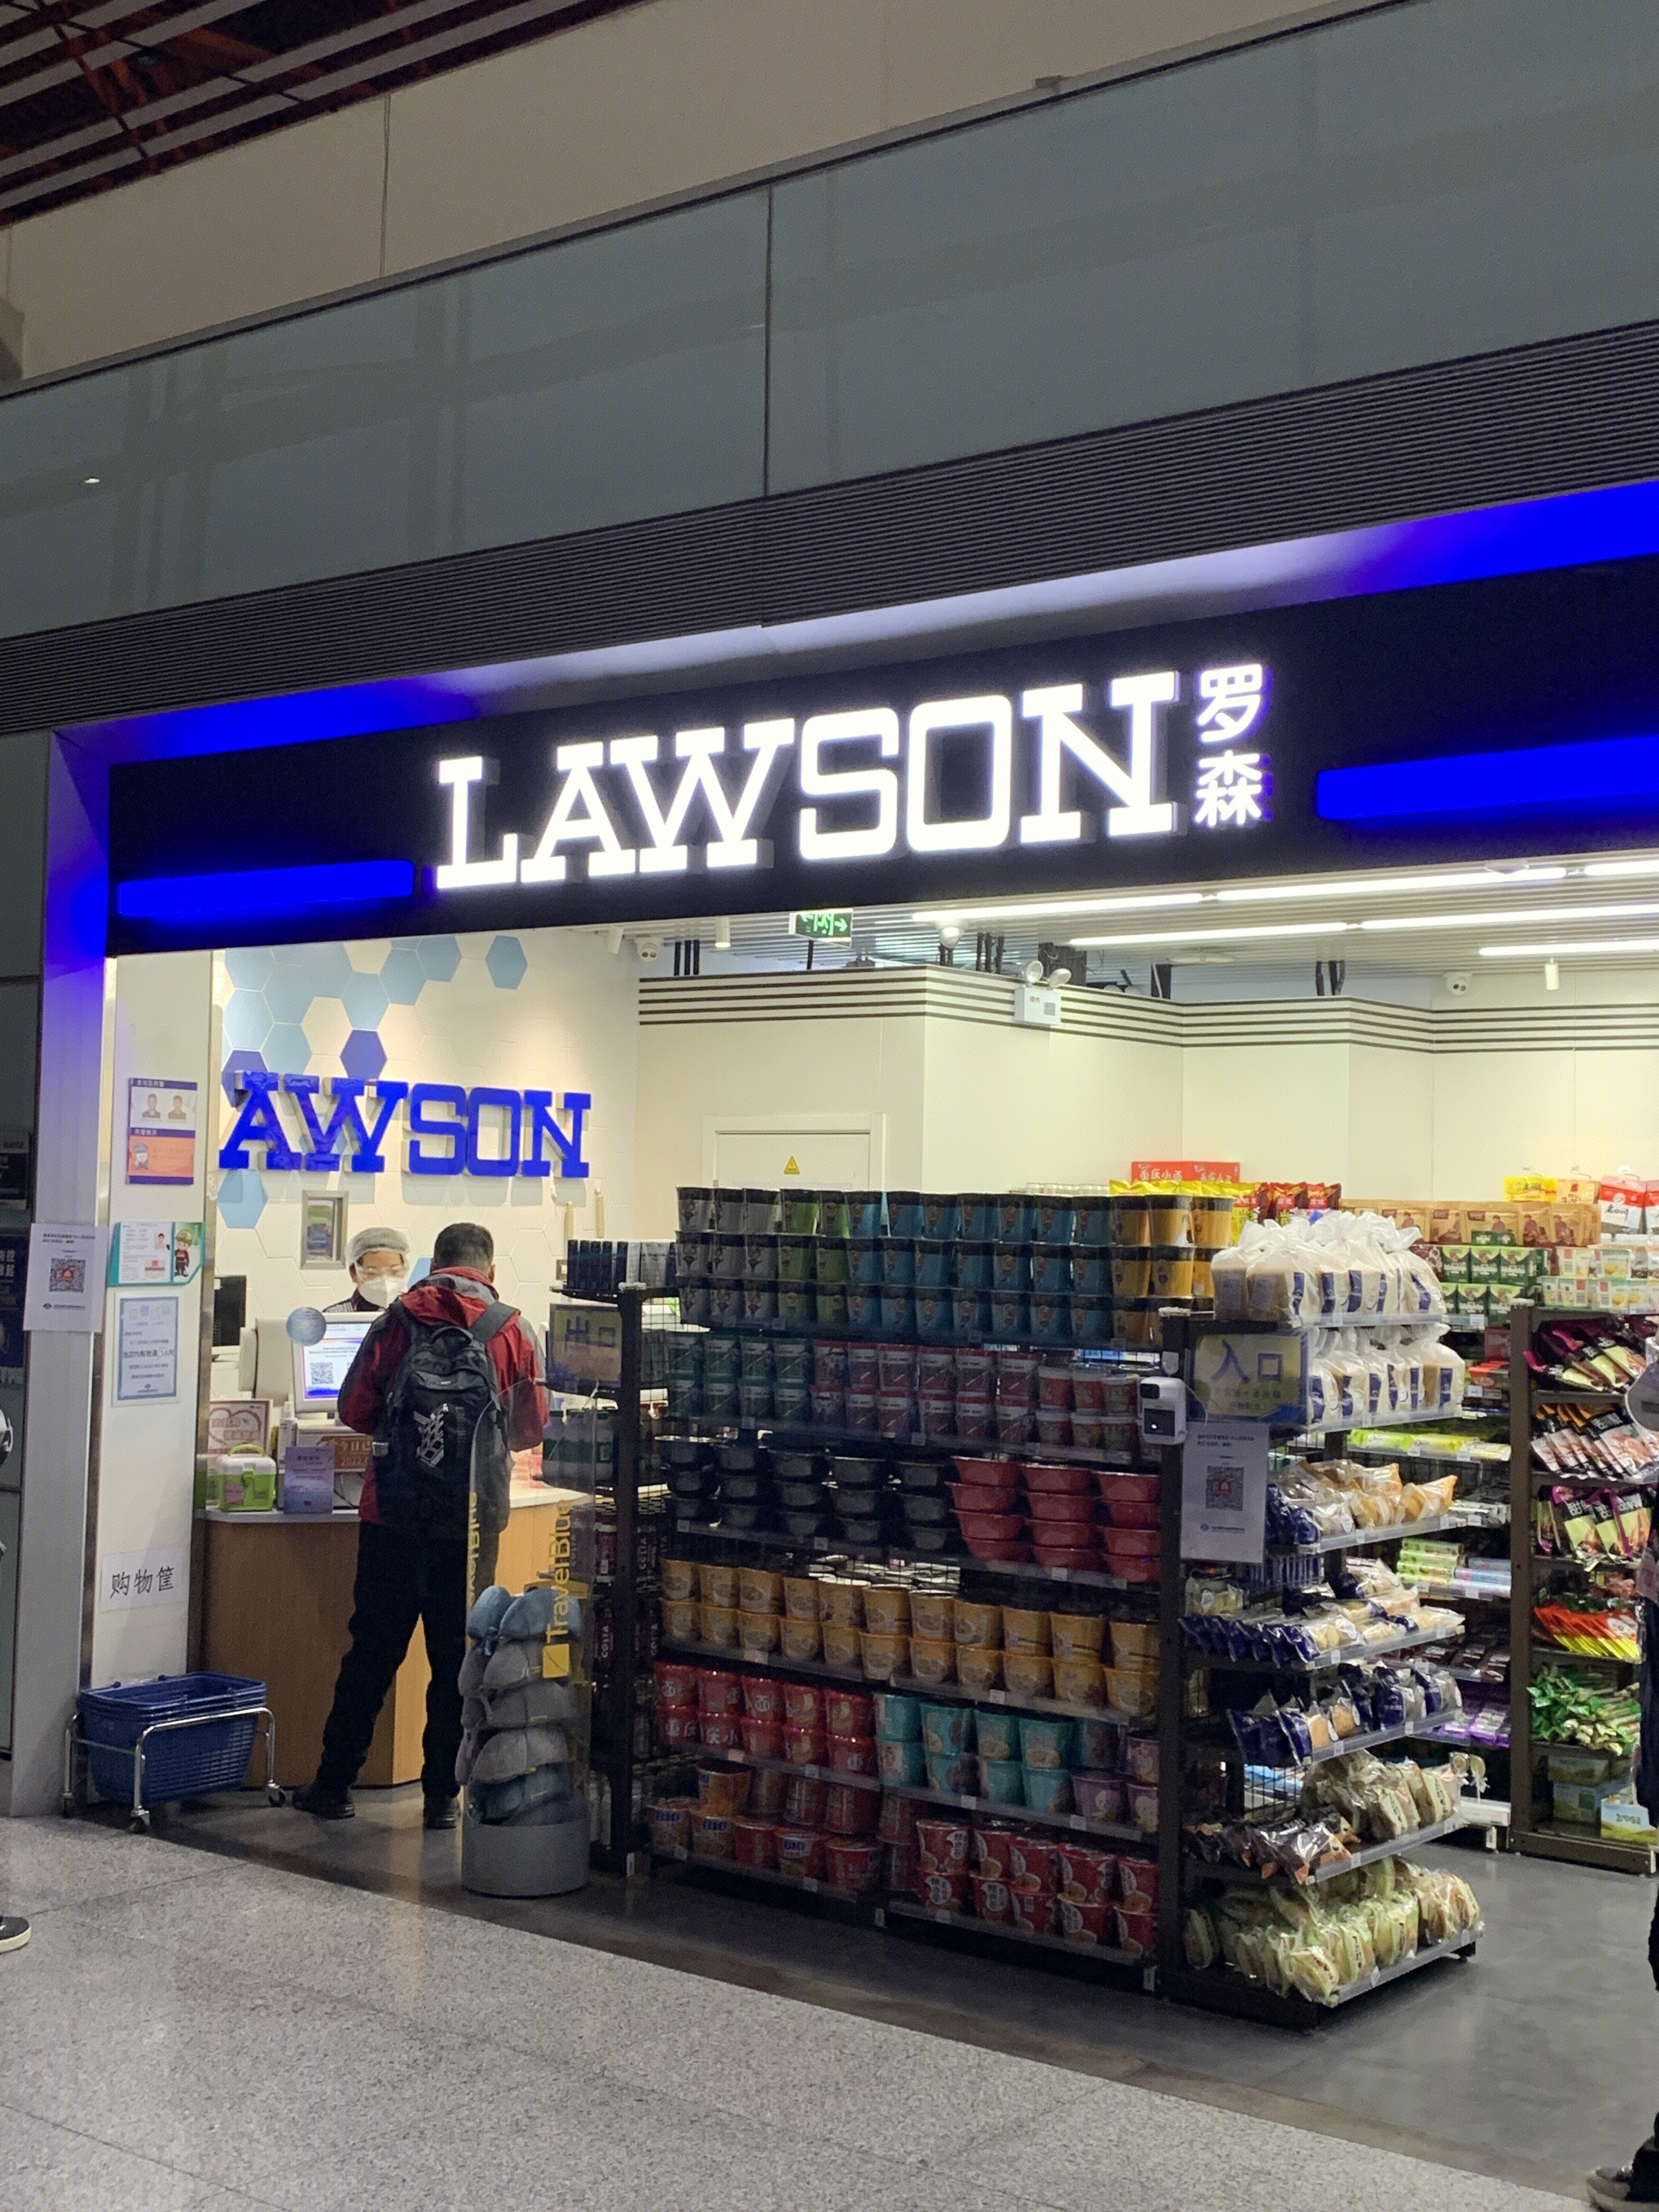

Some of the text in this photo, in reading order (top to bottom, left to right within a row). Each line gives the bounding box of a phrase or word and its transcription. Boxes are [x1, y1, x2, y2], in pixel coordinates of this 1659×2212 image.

[437, 672, 1177, 889] LAWSON
[1195, 664, 1263, 827] 罗森
[219, 1071, 591, 1178] AWSON
[565, 1316, 615, 1348] 出口
[1211, 1340, 1282, 1383] 入口
[110, 1566, 174, 1598] 购物筐
[546, 1500, 571, 1644] Travel Blue
